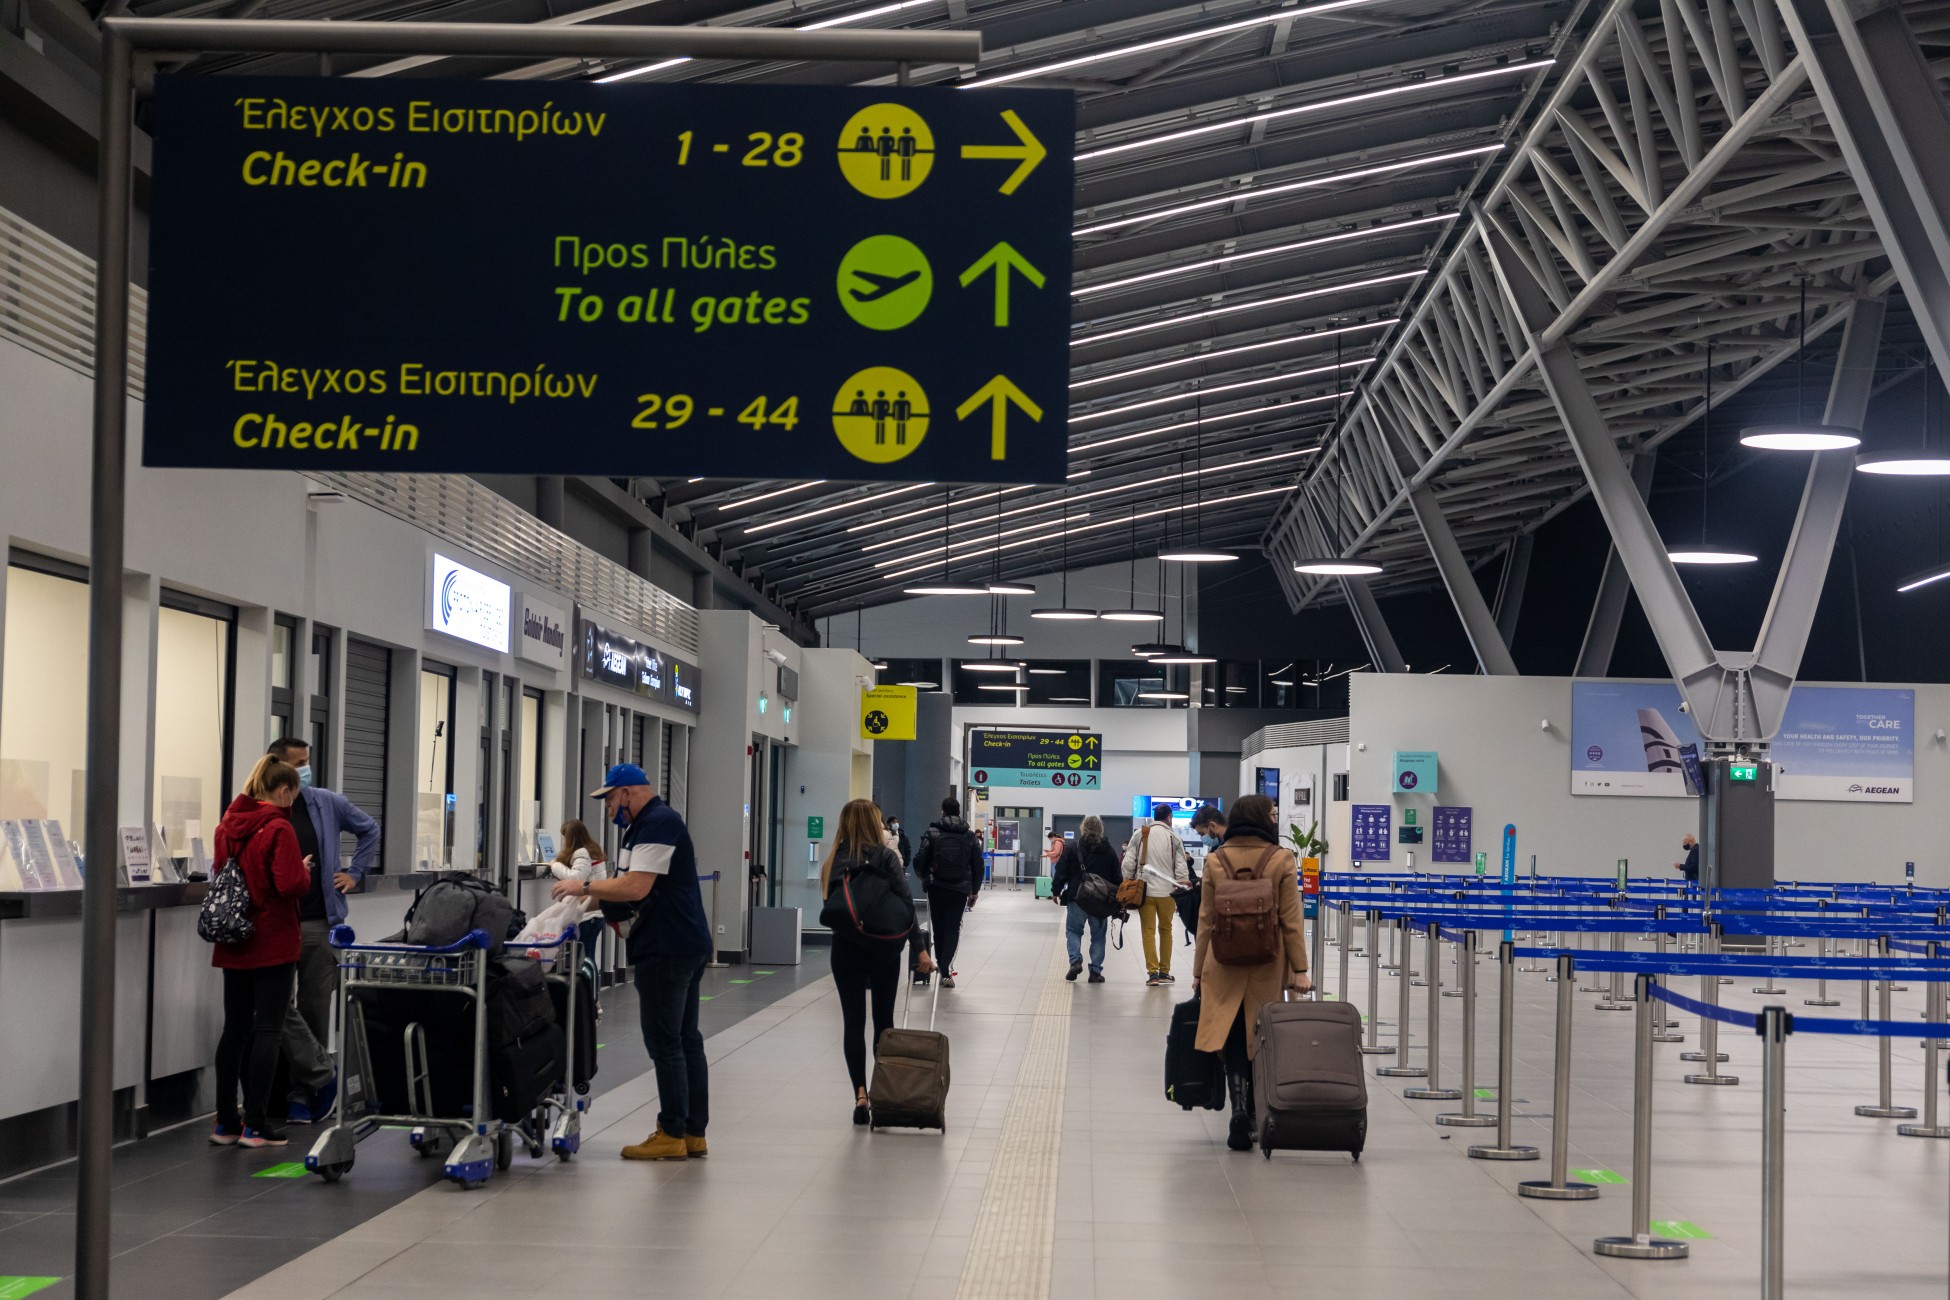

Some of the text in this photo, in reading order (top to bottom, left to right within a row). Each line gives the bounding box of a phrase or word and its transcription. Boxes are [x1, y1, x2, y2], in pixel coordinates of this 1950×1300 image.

[235, 97, 607, 141] Έλεγχος Εισιτηρίων
[677, 130, 805, 168] 1 - 28
[241, 150, 428, 189] Check-in
[554, 235, 777, 275] Προς Πύλες
[554, 286, 811, 334] To all gates
[225, 359, 598, 405] Έλεγχος Εισιτηρίων
[232, 412, 419, 451] Check-in
[631, 393, 799, 431] 29 - 44
[1869, 720, 1901, 729] CARE
[1864, 786, 1900, 794] AEGEAN
